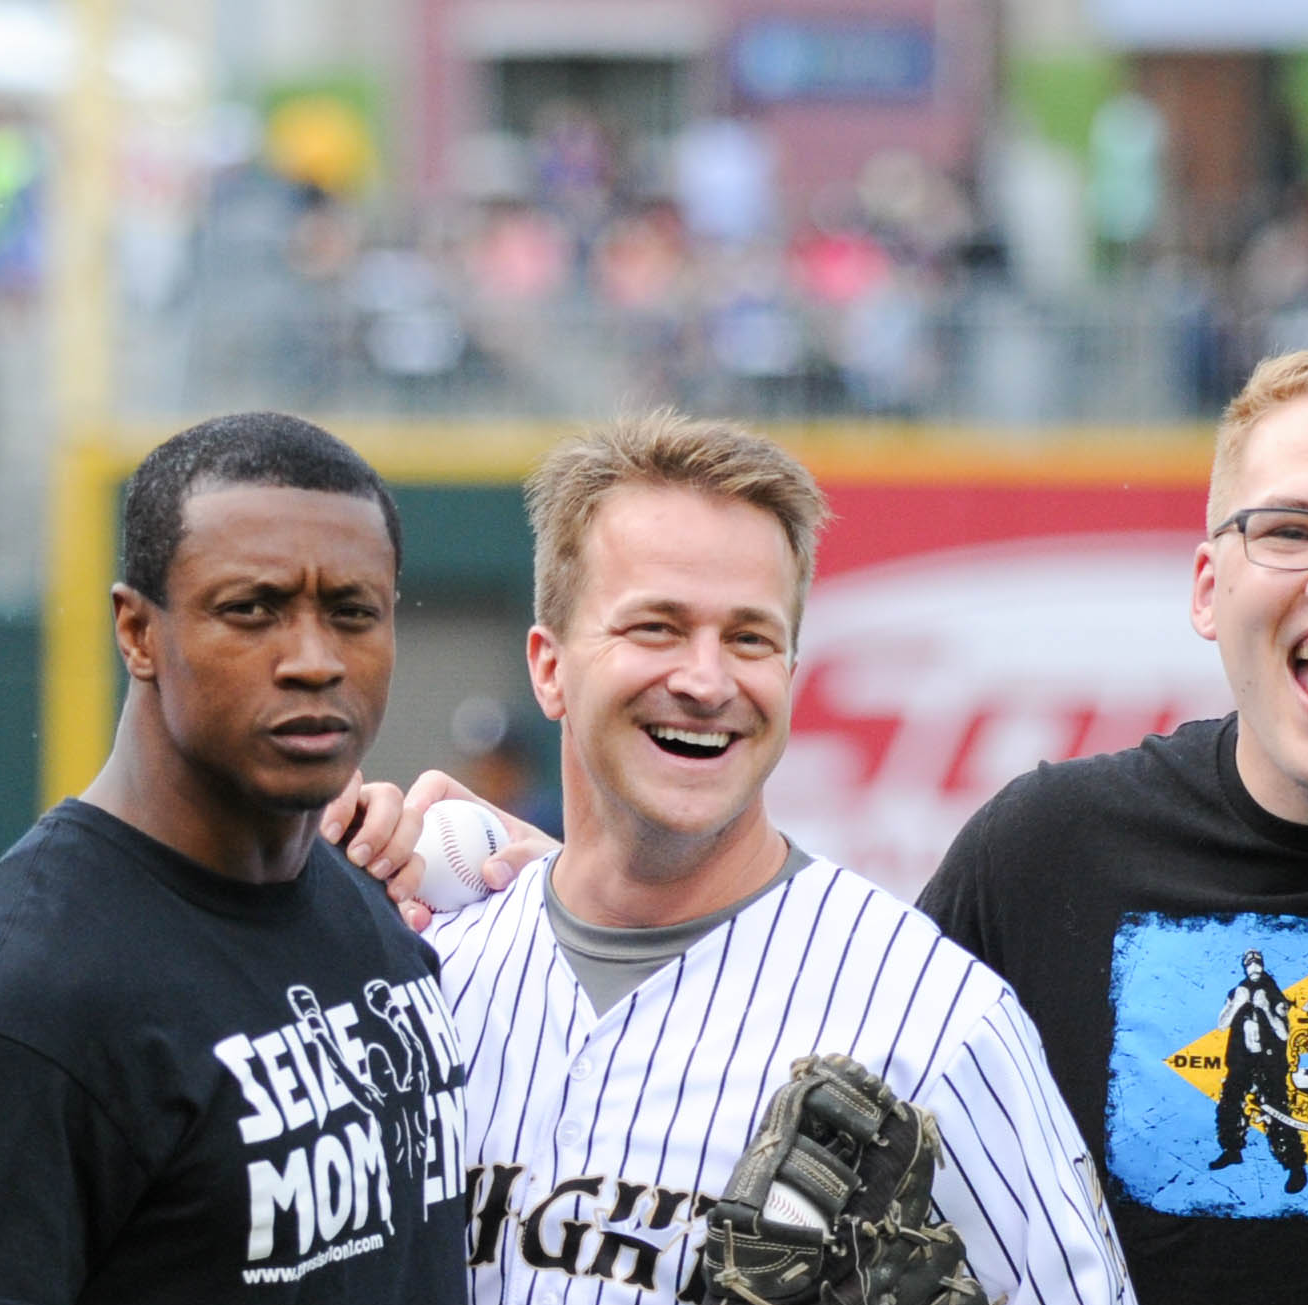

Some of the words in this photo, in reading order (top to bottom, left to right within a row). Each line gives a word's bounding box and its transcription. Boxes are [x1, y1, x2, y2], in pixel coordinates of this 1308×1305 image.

[213, 1002, 370, 1144] SEIZE
[391, 975, 465, 1084] TH
[1174, 1053, 1222, 1071] DEM
